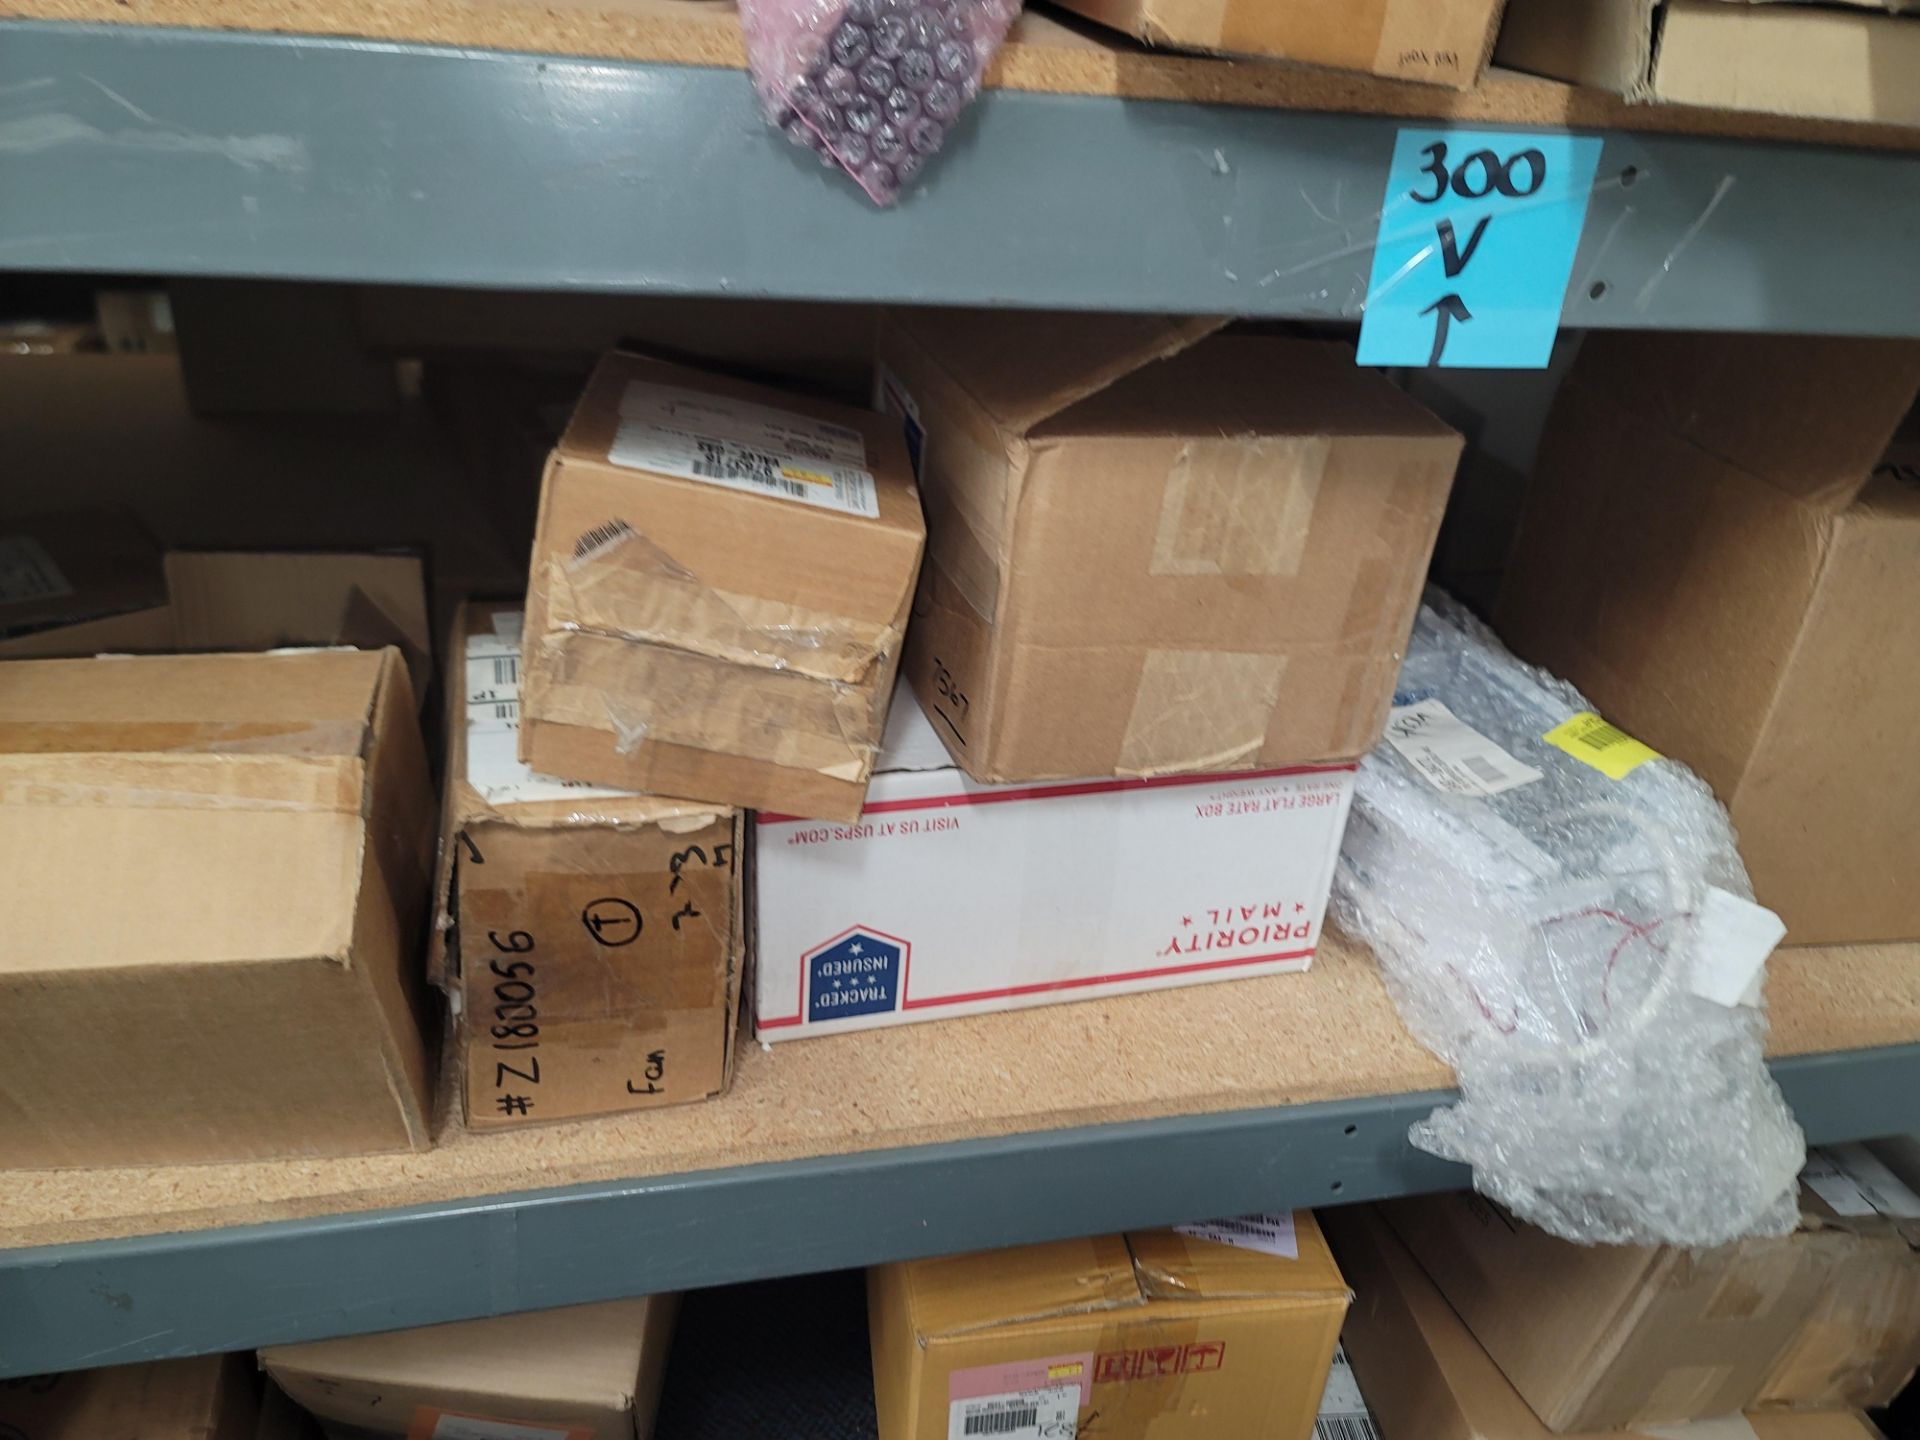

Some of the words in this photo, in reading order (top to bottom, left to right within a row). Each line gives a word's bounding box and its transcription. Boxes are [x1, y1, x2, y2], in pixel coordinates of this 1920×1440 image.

[1408, 139, 1547, 205] 300
[1436, 215, 1492, 279] V
[1226, 798, 1261, 816] RATE
[1263, 795, 1296, 813] FLAT
[1298, 791, 1341, 810] LARGE
[1194, 801, 1224, 820] BOX
[873, 821, 895, 837] AT
[898, 819, 920, 835] US
[921, 814, 959, 832] VISIT
[1205, 901, 1282, 926] MAIL
[626, 1049, 666, 1096] Fan
